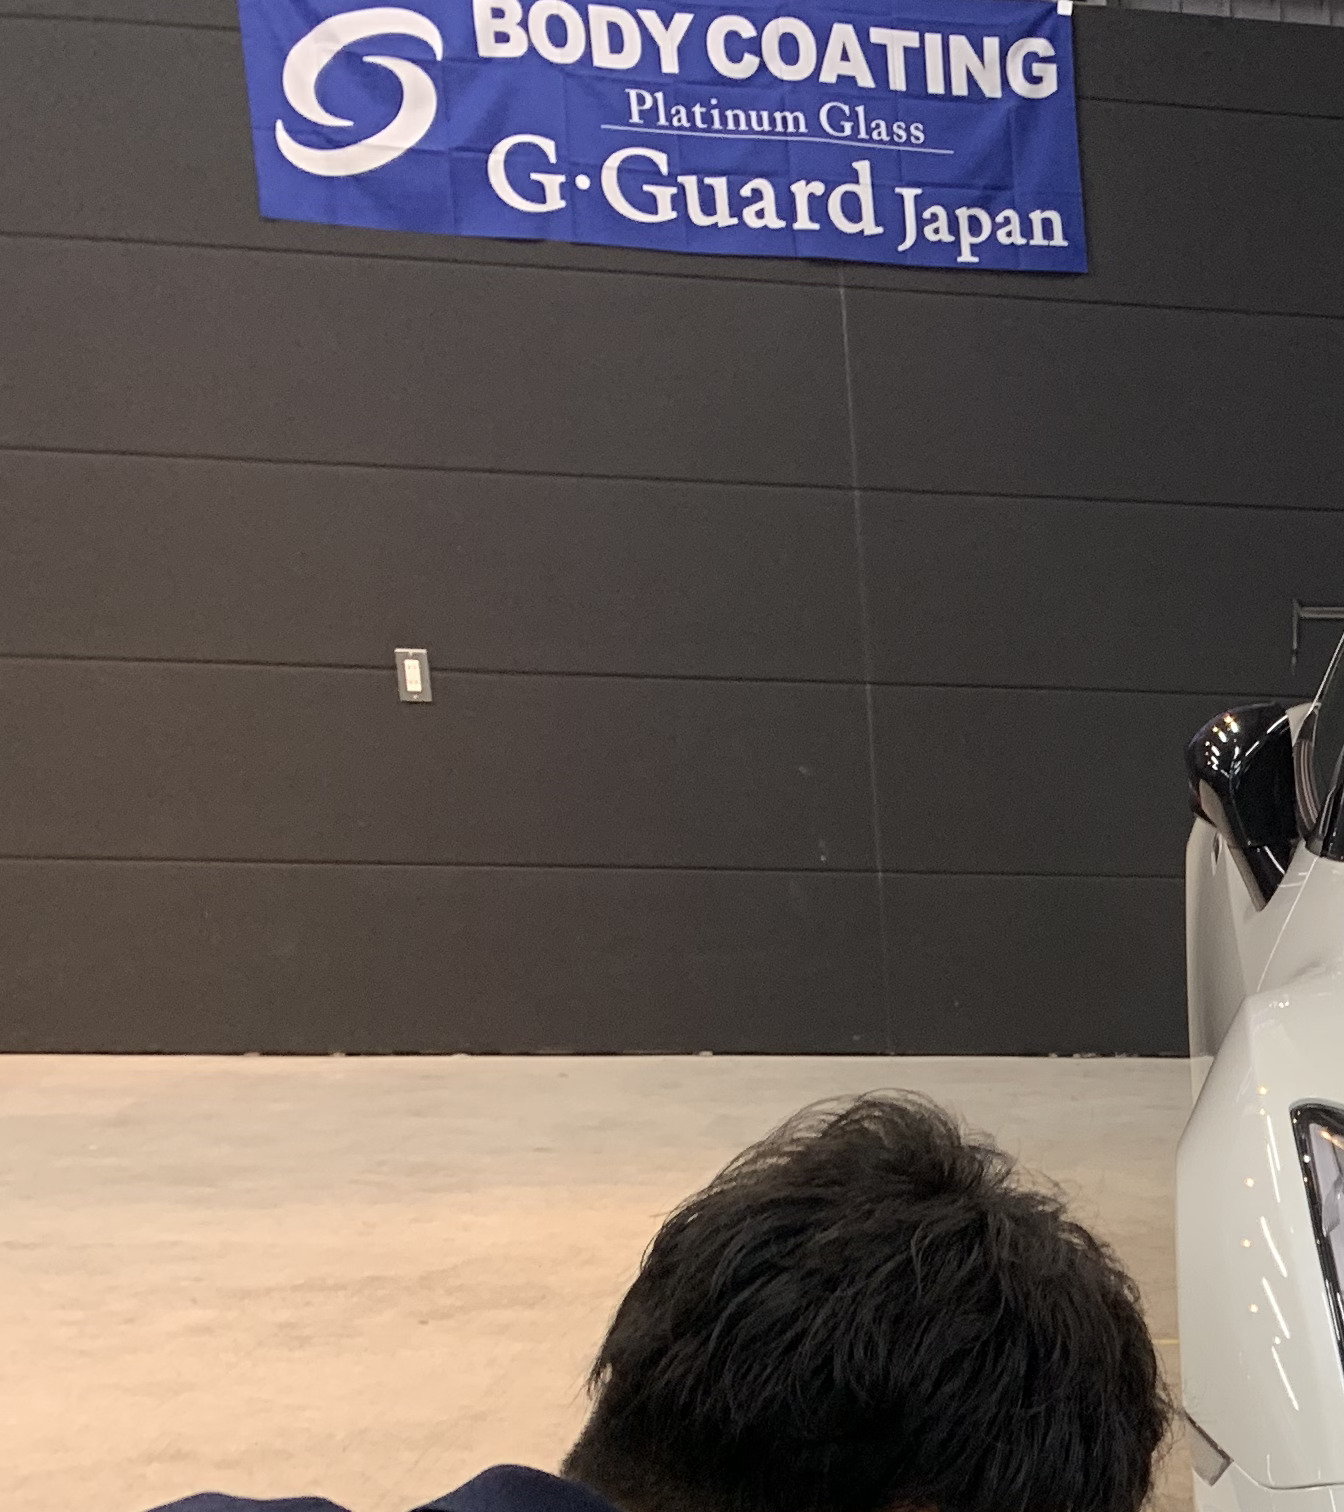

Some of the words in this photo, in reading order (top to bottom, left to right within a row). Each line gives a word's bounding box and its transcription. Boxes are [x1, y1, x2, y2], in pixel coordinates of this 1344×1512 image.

[473, 0, 695, 74] BODY
[706, 14, 1059, 99] COATING
[626, 88, 806, 134] Platinum
[818, 102, 926, 145] Glass
[896, 187, 1069, 263] Japan
